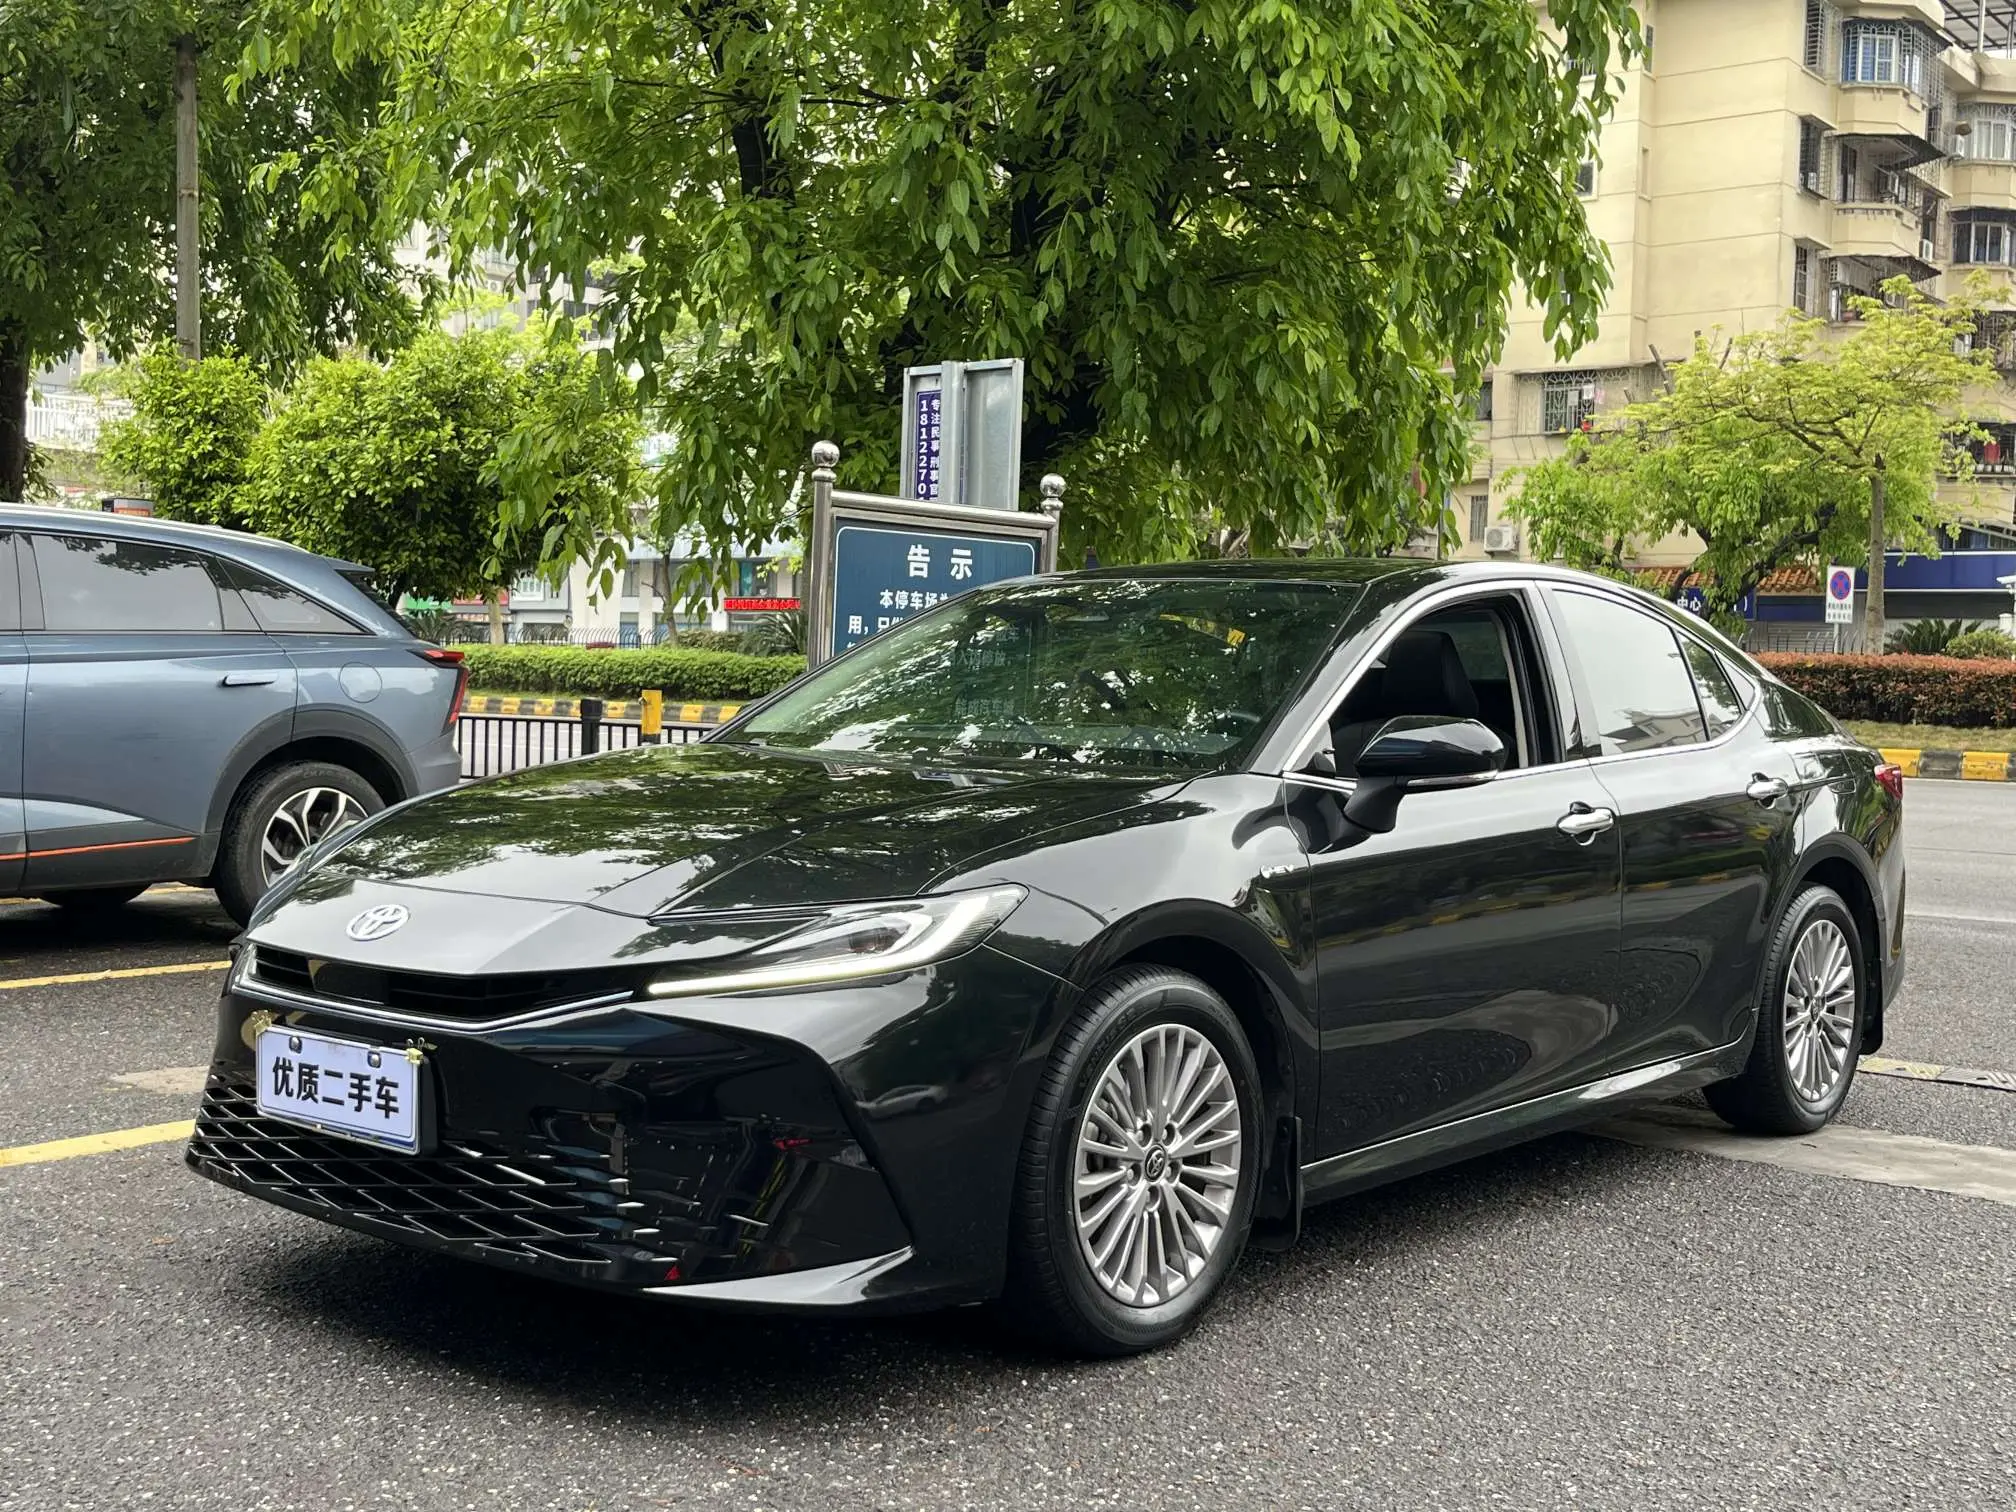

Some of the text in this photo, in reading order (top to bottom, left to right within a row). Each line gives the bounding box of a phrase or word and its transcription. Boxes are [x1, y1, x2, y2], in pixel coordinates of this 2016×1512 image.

[918, 399, 929, 500] 1812270
[907, 543, 973, 580] 告示
[271, 1056, 400, 1120] 优质二手车
